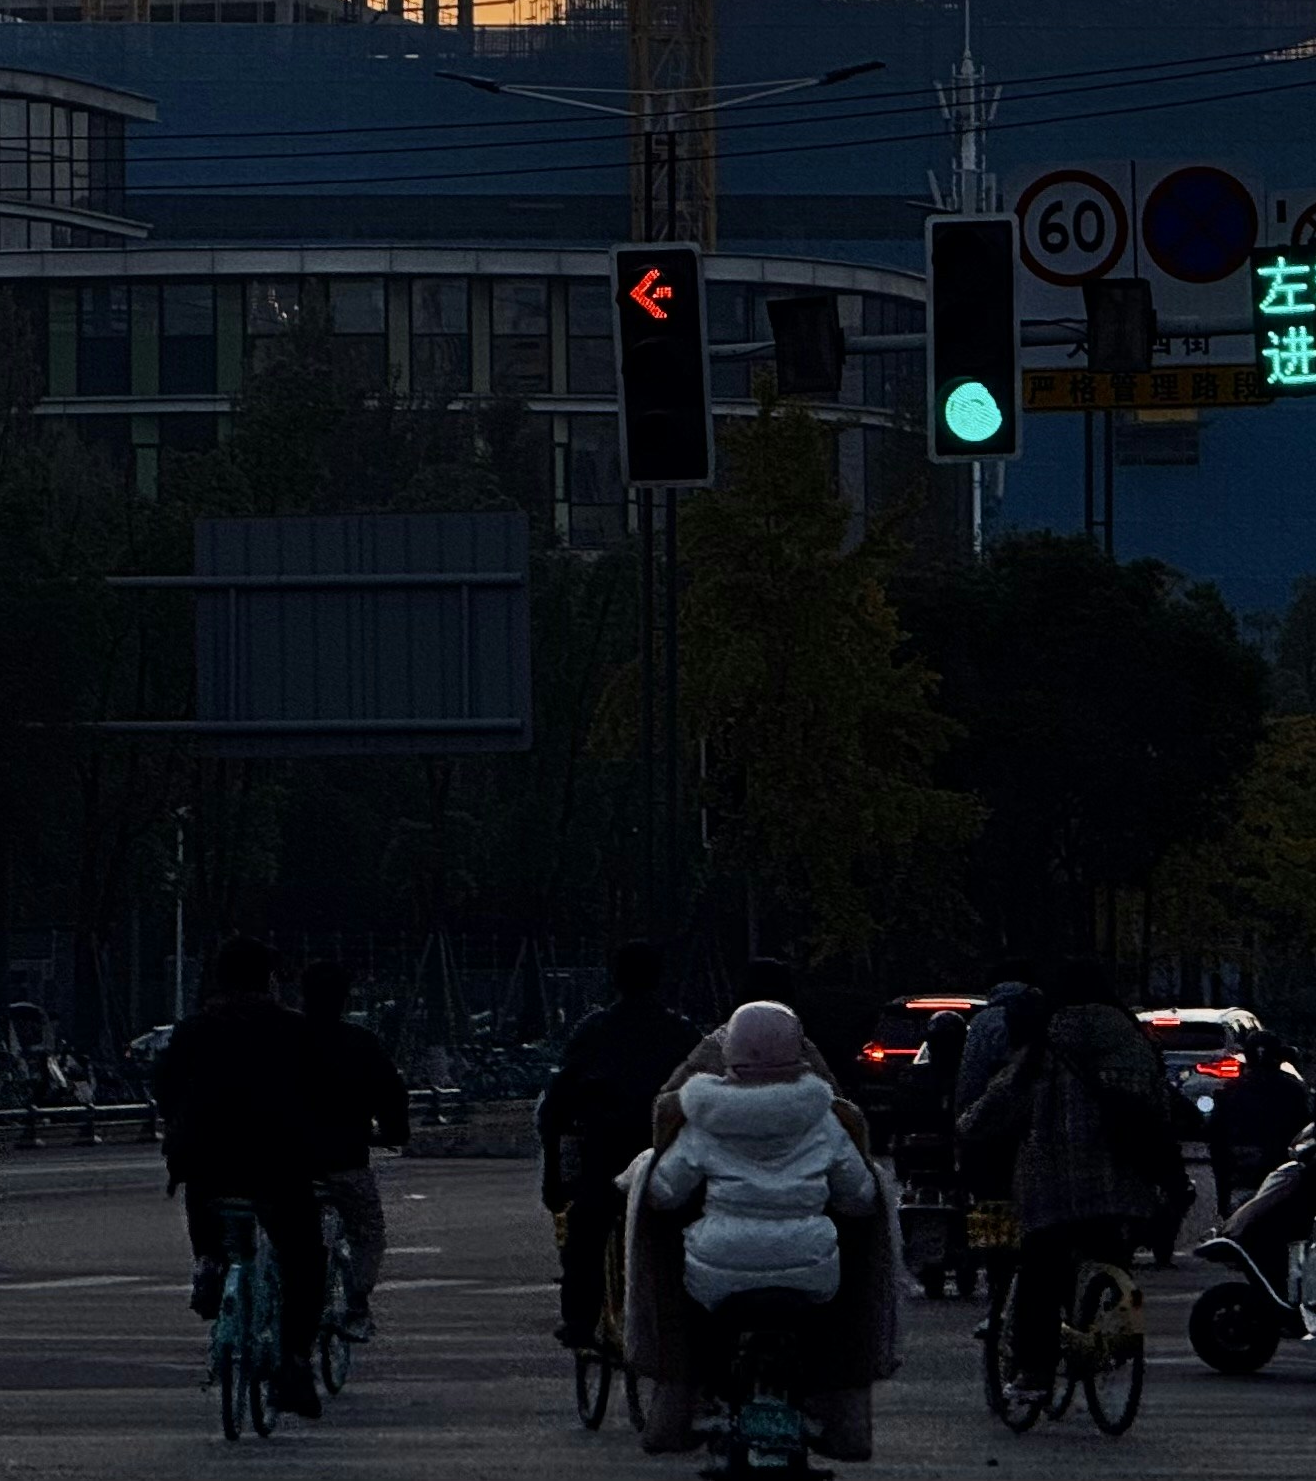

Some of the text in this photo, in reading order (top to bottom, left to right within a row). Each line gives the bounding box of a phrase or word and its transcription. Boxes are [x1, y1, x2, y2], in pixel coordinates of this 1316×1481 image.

[1039, 200, 1105, 253] 60
[1028, 370, 1260, 404] 严格管理路段
